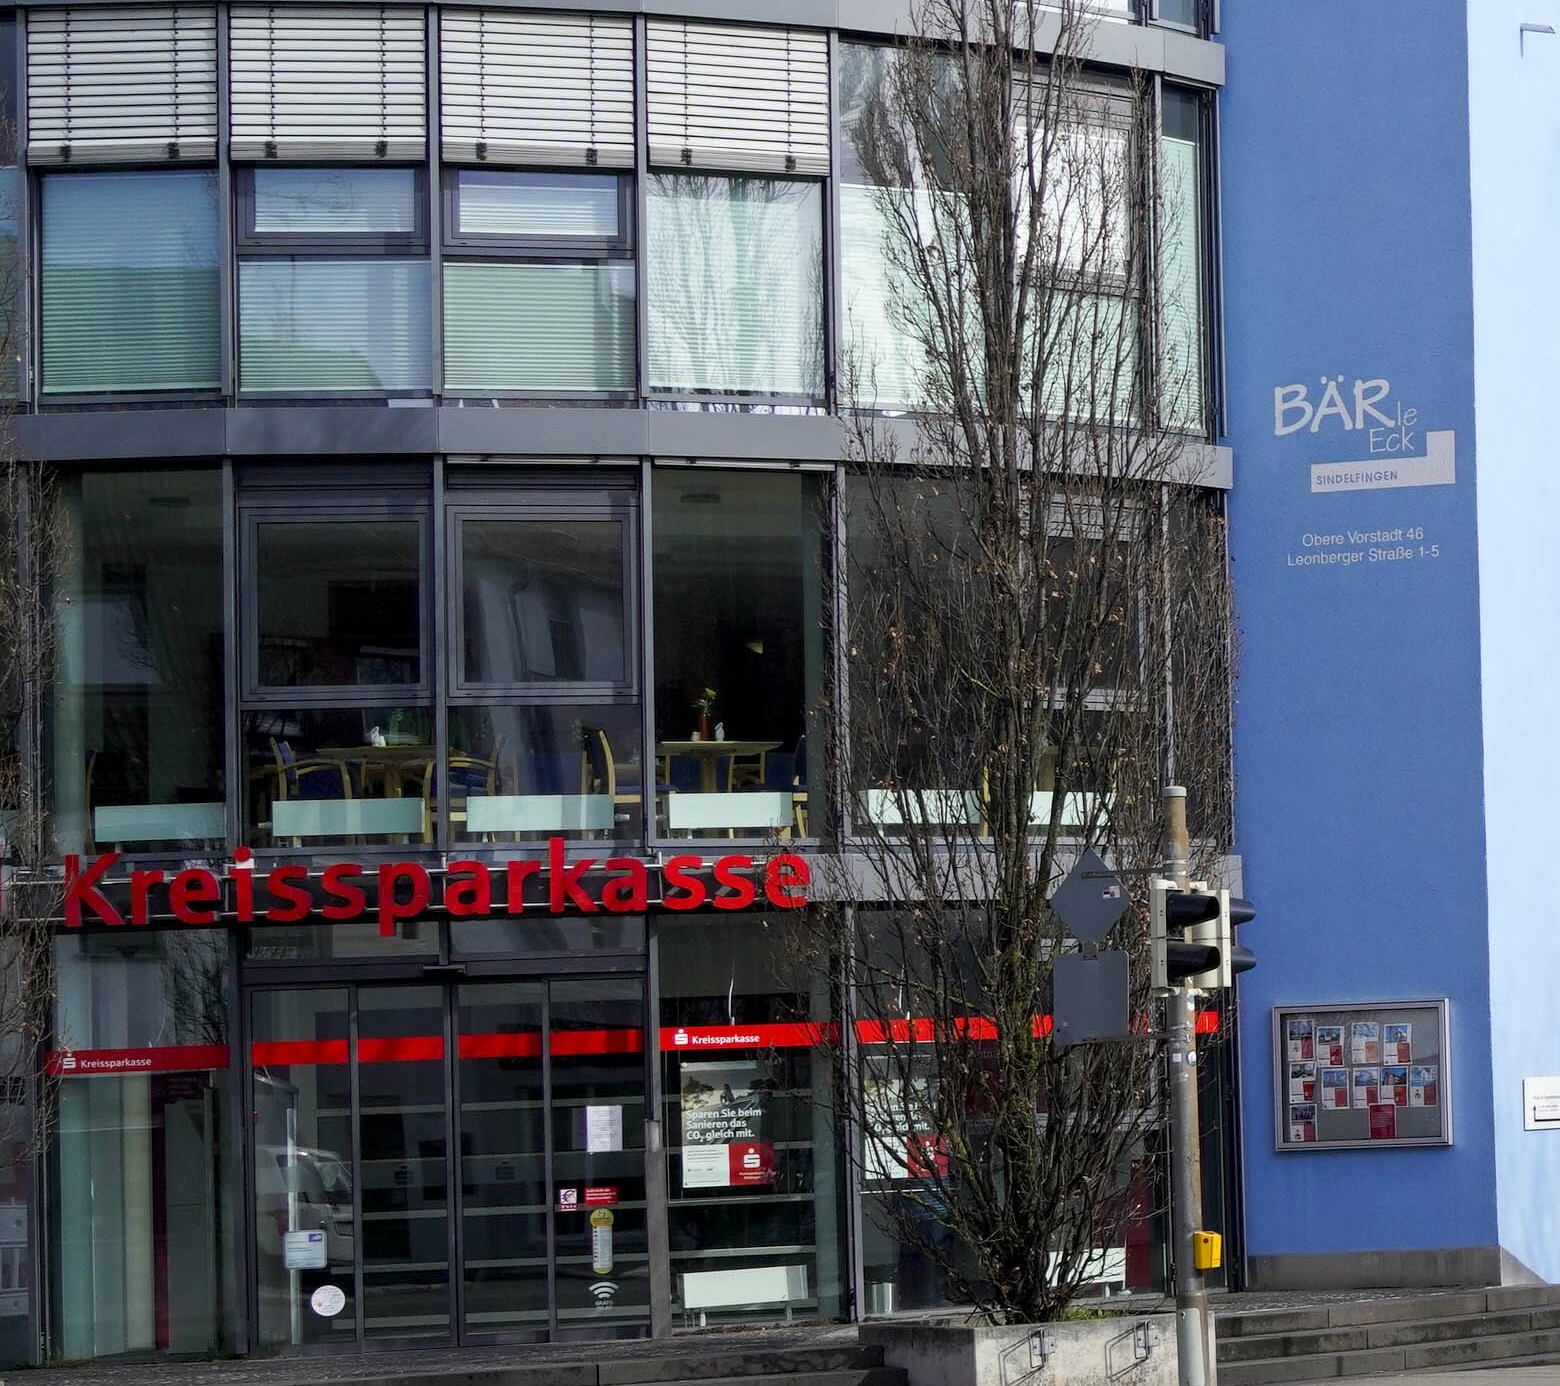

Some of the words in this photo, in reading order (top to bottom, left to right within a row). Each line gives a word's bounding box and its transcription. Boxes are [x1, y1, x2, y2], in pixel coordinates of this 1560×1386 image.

[1369, 426, 1416, 453] Eck
[1316, 470, 1399, 486] SINDELFINGEN
[1302, 531, 1344, 547] Obere
[1347, 528, 1403, 544] Vorstadt
[1406, 526, 1424, 541] 46
[1288, 549, 1363, 566] Leonberger
[1368, 546, 1413, 562] Straße
[1418, 544, 1440, 558] 1-5
[64, 837, 812, 936] Kreissparkasse
[692, 1033, 760, 1046] Kreissparkasse
[81, 1056, 152, 1069] Kreissparkasse
[687, 1109, 720, 1120] Sparen
[721, 1108, 736, 1117] Sie
[738, 1107, 761, 1117] beim
[686, 1120, 729, 1130] Sanieren
[730, 1119, 747, 1128] das
[706, 1128, 734, 1140] gleich
[736, 1129, 755, 1138] mit.
